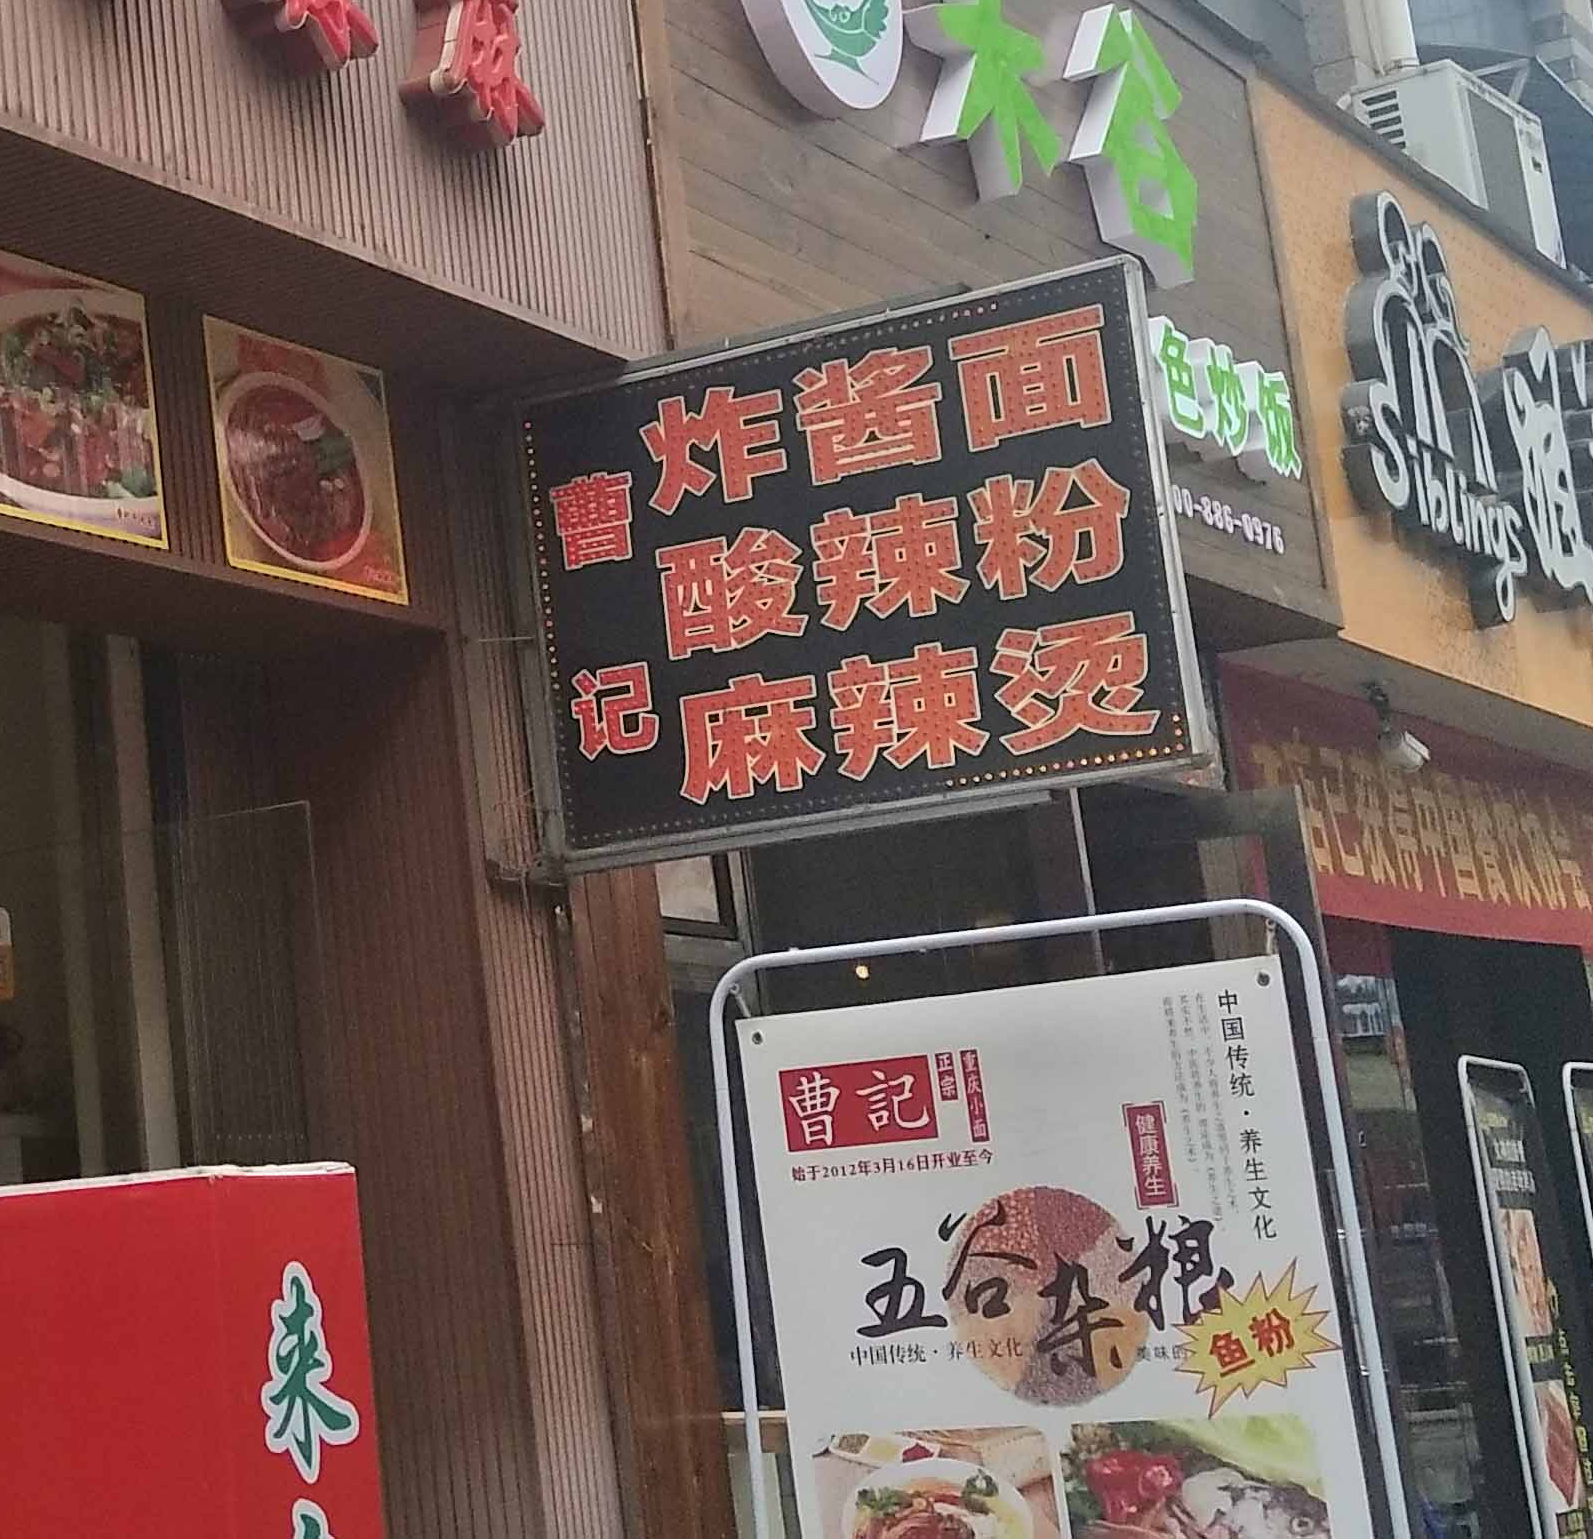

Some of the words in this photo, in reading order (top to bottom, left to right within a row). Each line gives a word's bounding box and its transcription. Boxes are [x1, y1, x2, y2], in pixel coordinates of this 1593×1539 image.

[639, 303, 1113, 516] 炸酱面
[656, 459, 1131, 660] 酸辣粉
[1368, 379, 1527, 623] Siblings
[679, 612, 1160, 804] 麻辣烫
[788, 1070, 930, 1146] 曹記
[936, 1053, 957, 1098] 正宗
[791, 1148, 994, 1182] 始于2012年3月16日开业至今
[1134, 1113, 1168, 1198] 健康养生
[856, 1200, 1236, 1377] 五谷杂粮
[1208, 1305, 1295, 1378] 鱼粉
